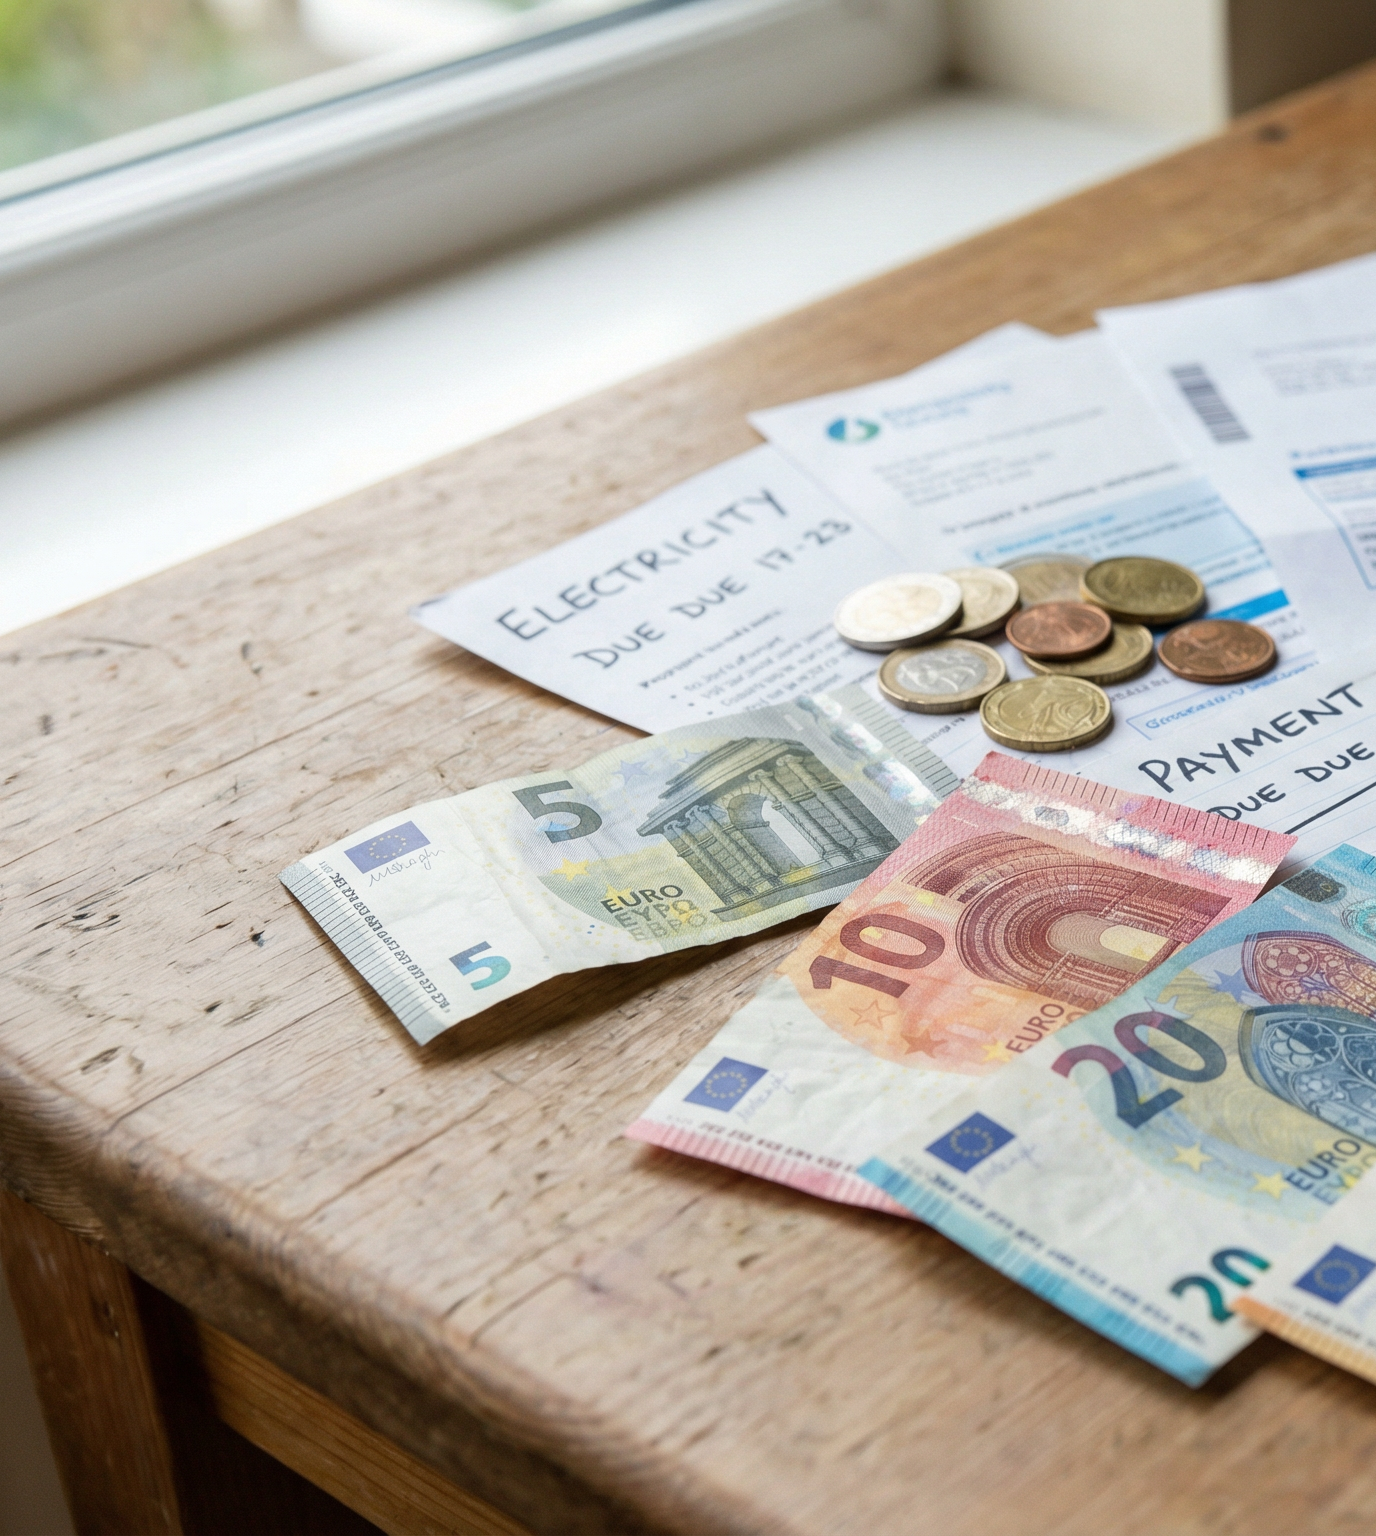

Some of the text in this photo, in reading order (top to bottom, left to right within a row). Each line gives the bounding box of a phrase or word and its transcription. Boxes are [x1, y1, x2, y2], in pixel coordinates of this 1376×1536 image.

[496, 488, 787, 641] ELECTRICITY
[573, 621, 665, 669] DUE
[670, 575, 747, 619] DUE
[1138, 682, 1363, 793] PAYMENT
[511, 780, 602, 844] 5
[1206, 783, 1286, 821] DUE
[1295, 742, 1375, 782] DUE
[600, 884, 683, 914] EURO
[449, 941, 512, 992] 5
[809, 914, 945, 998] 10
[1005, 1003, 1065, 1053] EURO
[1051, 1011, 1227, 1130] 20
[1285, 1138, 1361, 1191] EURO
